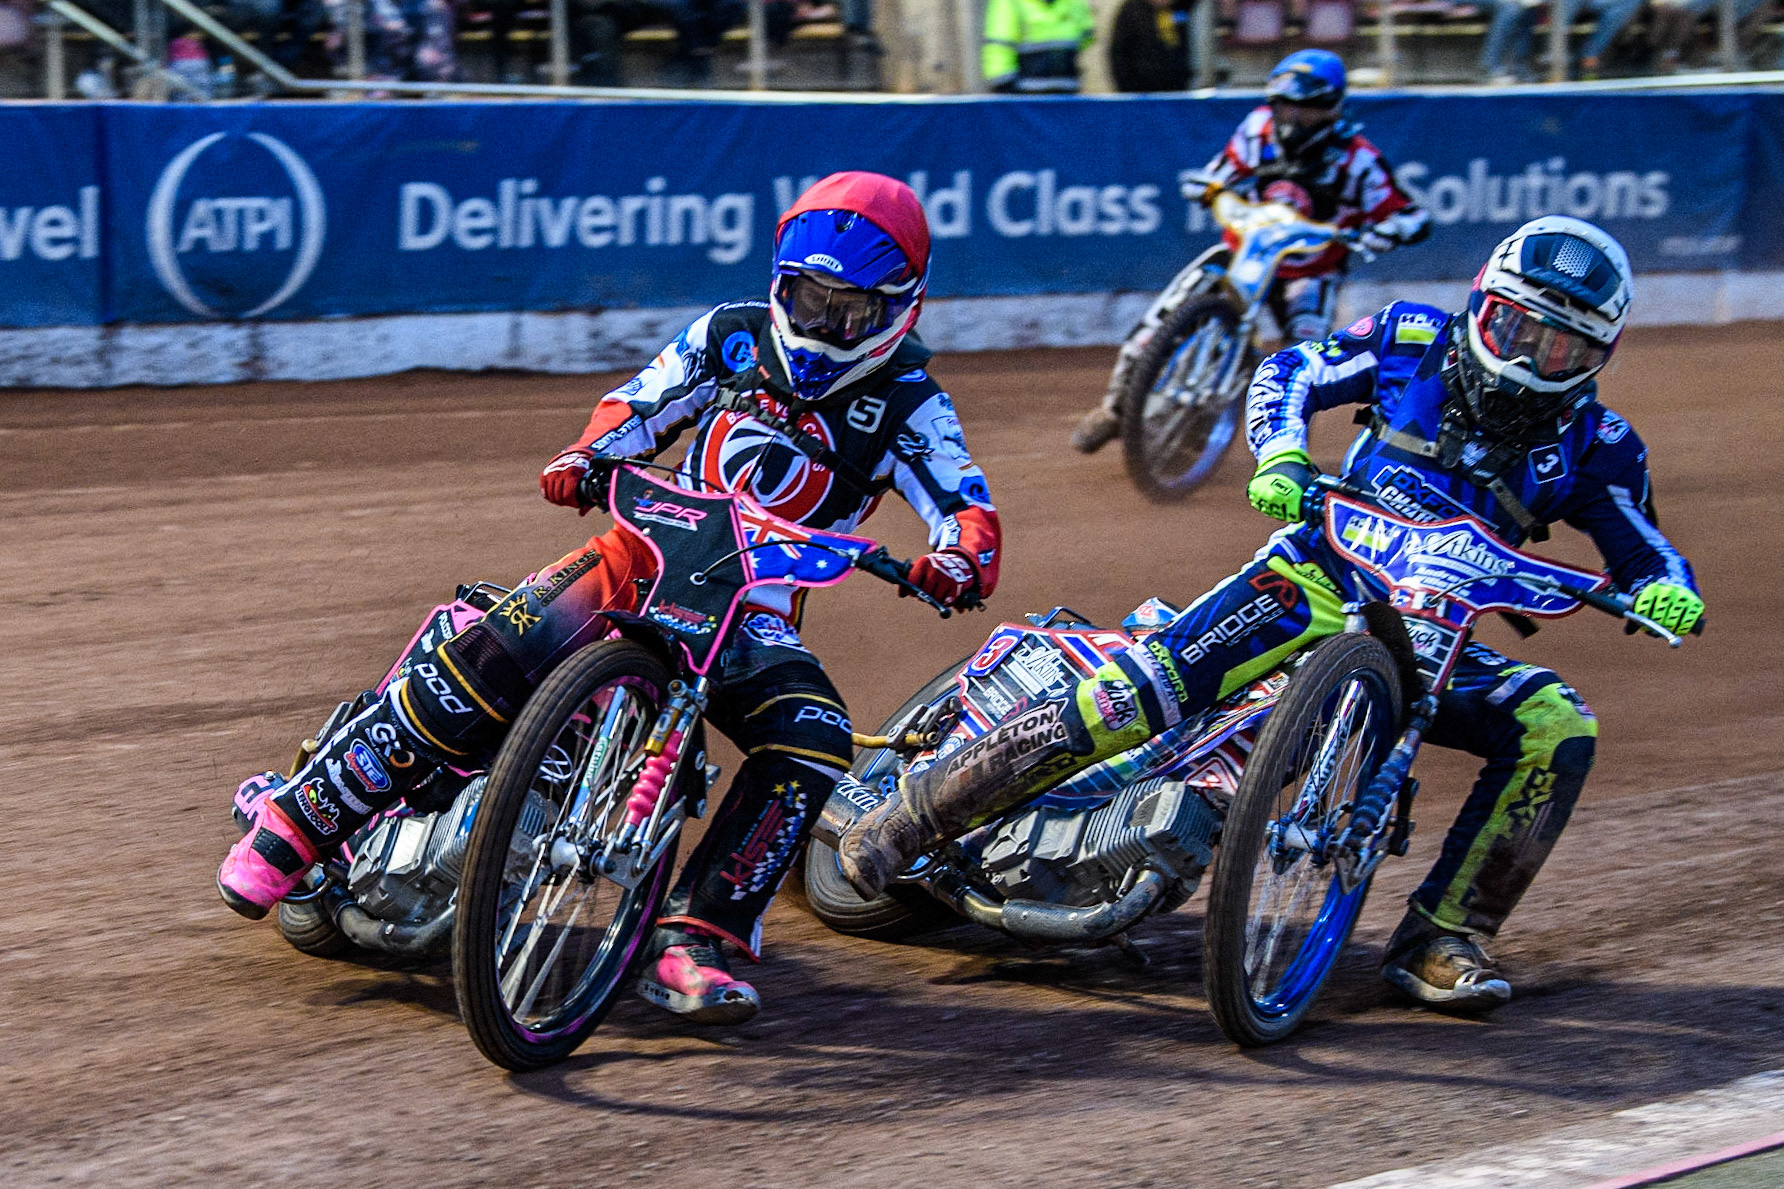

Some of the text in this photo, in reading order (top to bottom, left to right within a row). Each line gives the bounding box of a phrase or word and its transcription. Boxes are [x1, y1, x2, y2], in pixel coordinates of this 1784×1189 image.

[399, 178, 755, 263] Delivering
[987, 168, 1163, 237] Class
[1396, 157, 1670, 222] Solutions
[634, 502, 708, 531] JPR
[1180, 593, 1280, 666] BRIDGE
[982, 685, 1013, 717] BRIDGE
[1148, 640, 1189, 703] OXFORD
[948, 706, 1059, 773] APPLETON
[987, 722, 1067, 778] RACING
